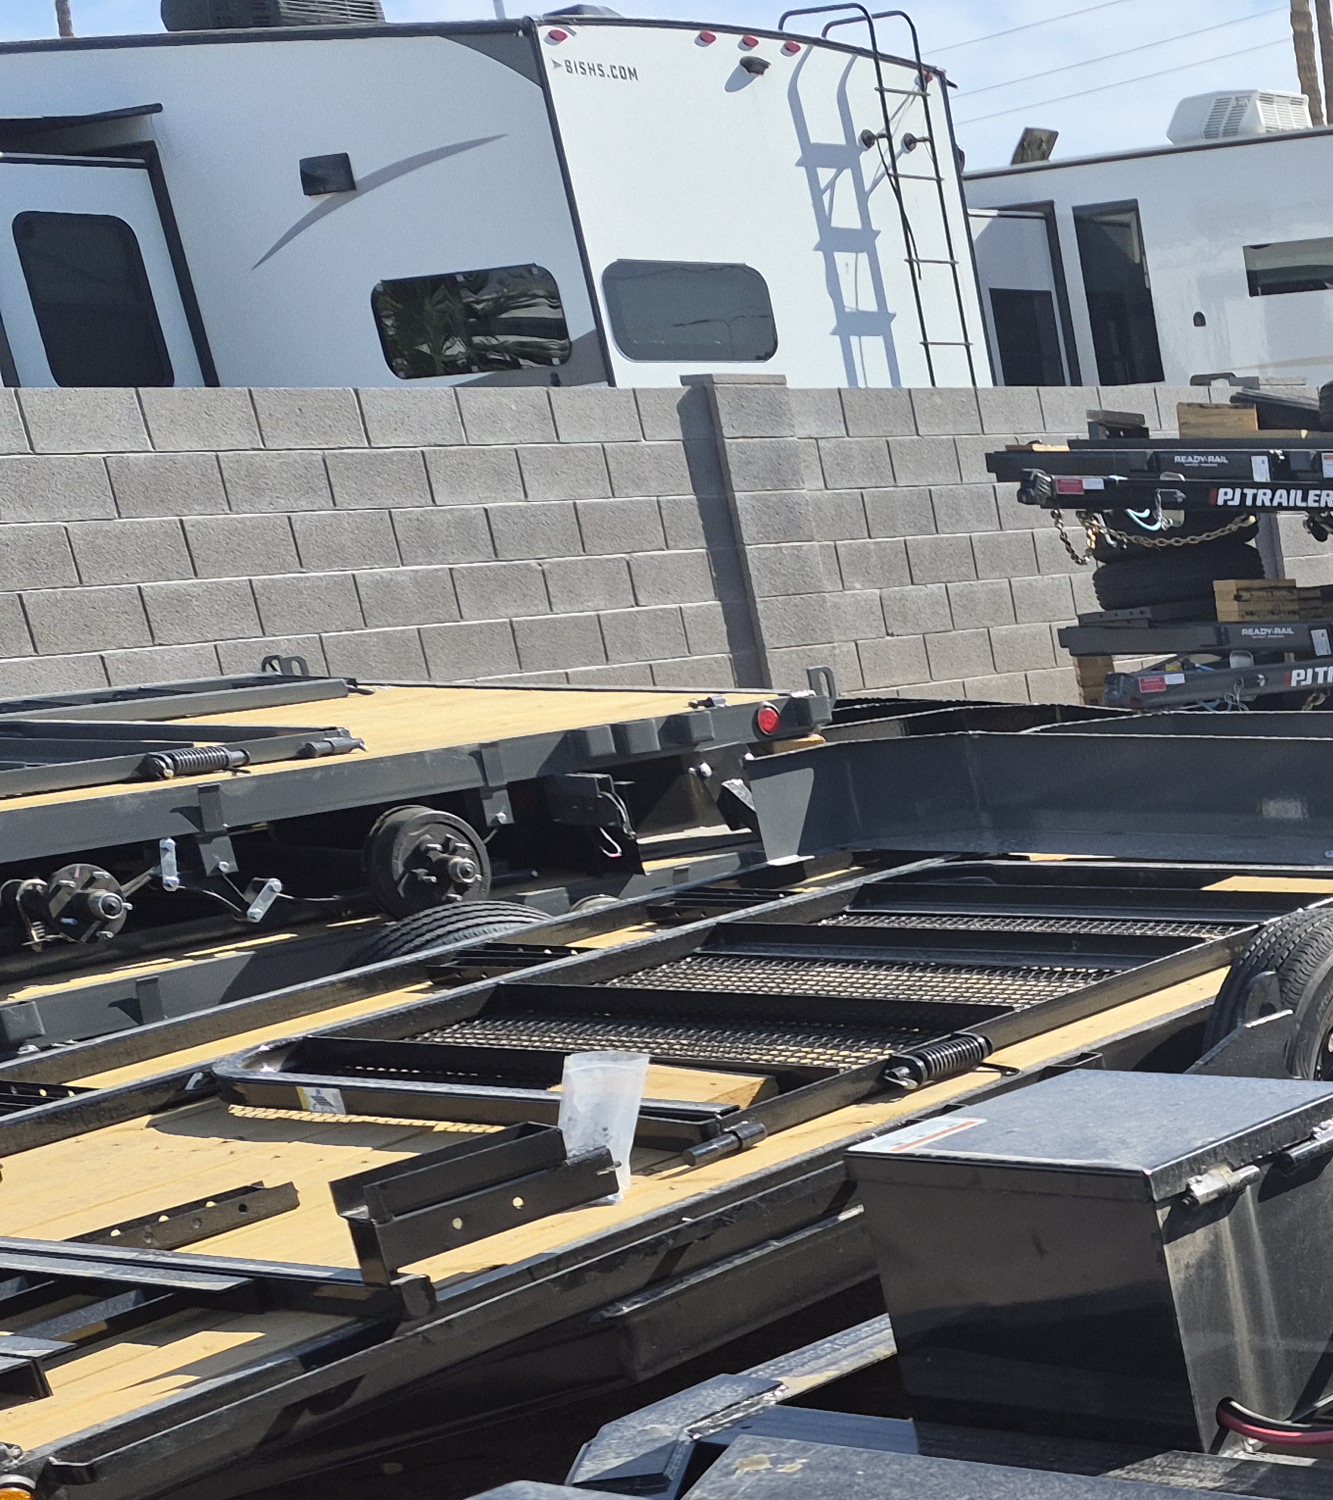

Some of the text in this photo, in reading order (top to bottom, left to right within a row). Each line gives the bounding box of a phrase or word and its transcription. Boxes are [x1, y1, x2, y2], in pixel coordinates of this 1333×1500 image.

[564, 60, 638, 81] BISHS.COM
[1217, 487, 1241, 506] PJ
[1291, 667, 1314, 687] PJ
